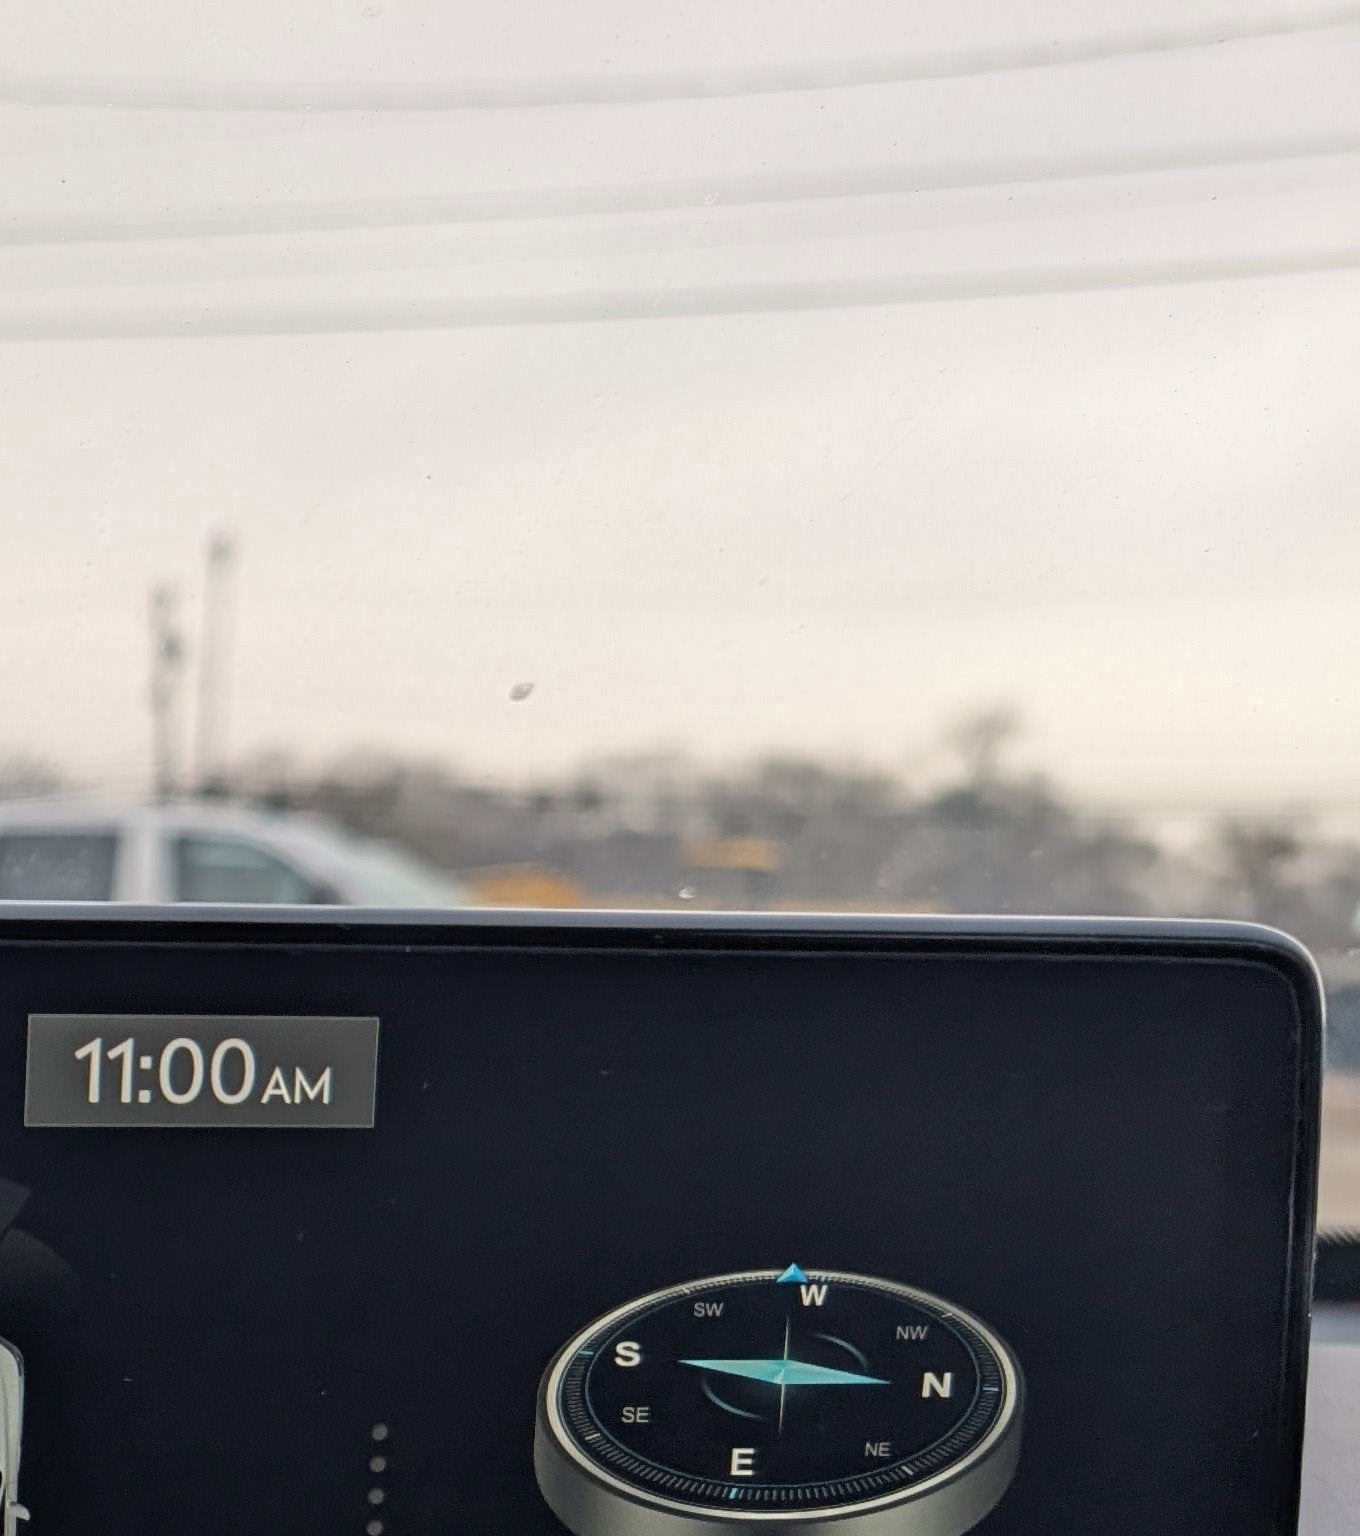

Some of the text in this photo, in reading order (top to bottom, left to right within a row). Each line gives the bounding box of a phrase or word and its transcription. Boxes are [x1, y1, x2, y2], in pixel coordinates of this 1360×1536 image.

[799, 1283, 829, 1308] W
[692, 1300, 725, 1319] SW
[894, 1324, 930, 1342] NW
[613, 1340, 642, 1368] S
[920, 1371, 953, 1399] N
[620, 1405, 651, 1425] SE
[863, 1440, 892, 1458] NE
[729, 1446, 756, 1477] E
